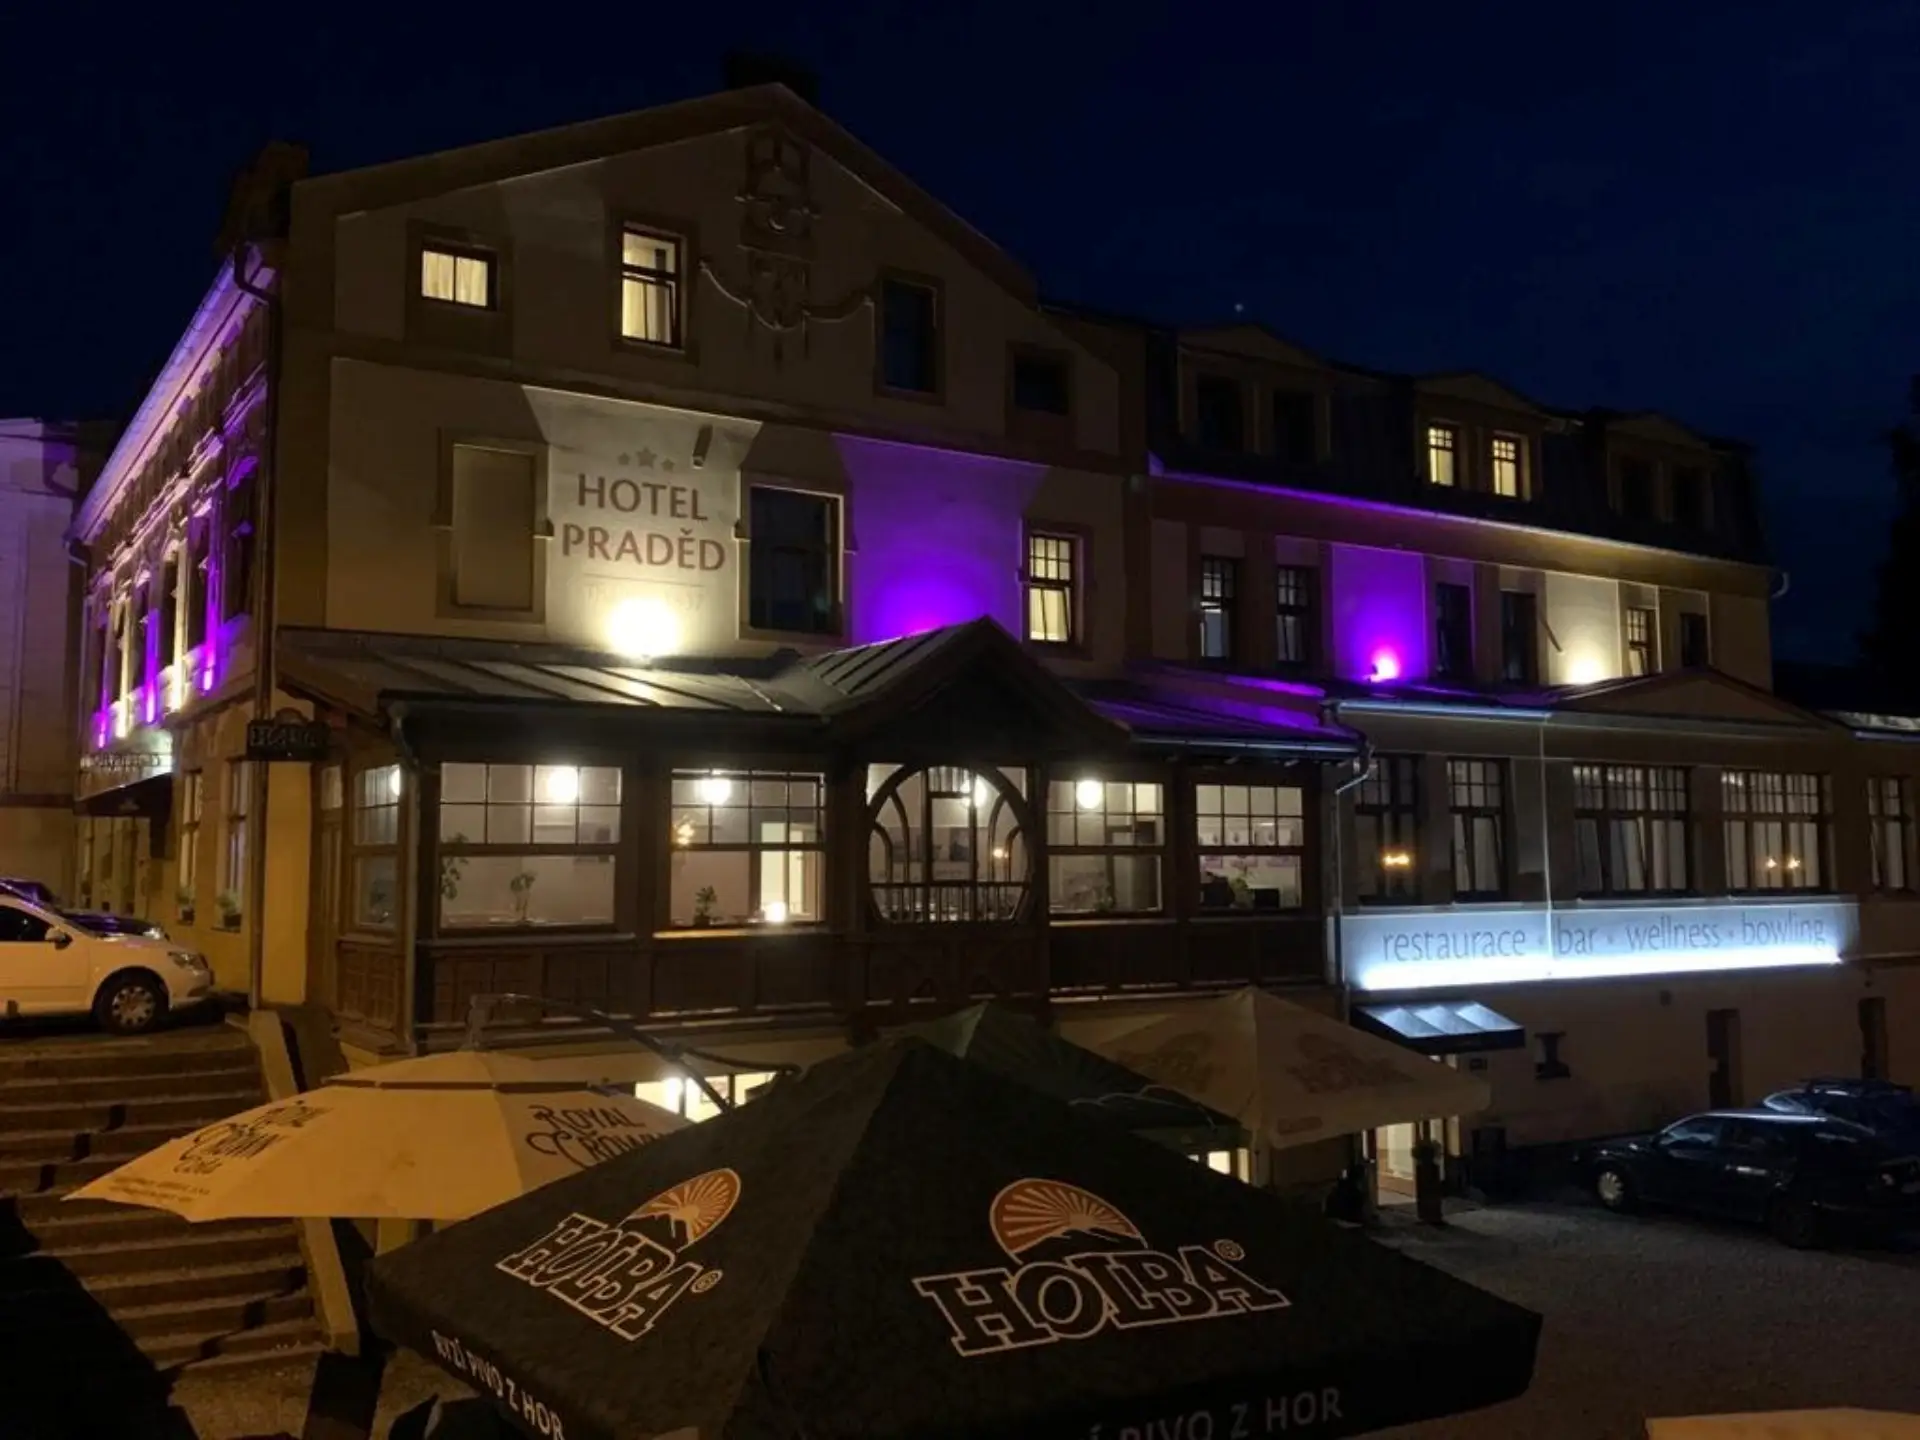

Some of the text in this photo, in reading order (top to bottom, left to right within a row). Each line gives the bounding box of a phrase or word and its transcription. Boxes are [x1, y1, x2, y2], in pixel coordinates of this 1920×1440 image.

[578, 473, 708, 521] HOTEL
[562, 523, 726, 571] PRADĚD
[1382, 908, 1826, 962] restaurace bar wellness bowling
[528, 1105, 646, 1136] ROYAL
[495, 1212, 704, 1341] HOLBA
[911, 1245, 1292, 1356] HOLBA
[505, 1376, 520, 1412] Z
[521, 1388, 566, 1440] HOR
[1229, 1402, 1250, 1440] Z
[1265, 1385, 1344, 1433] HOR
